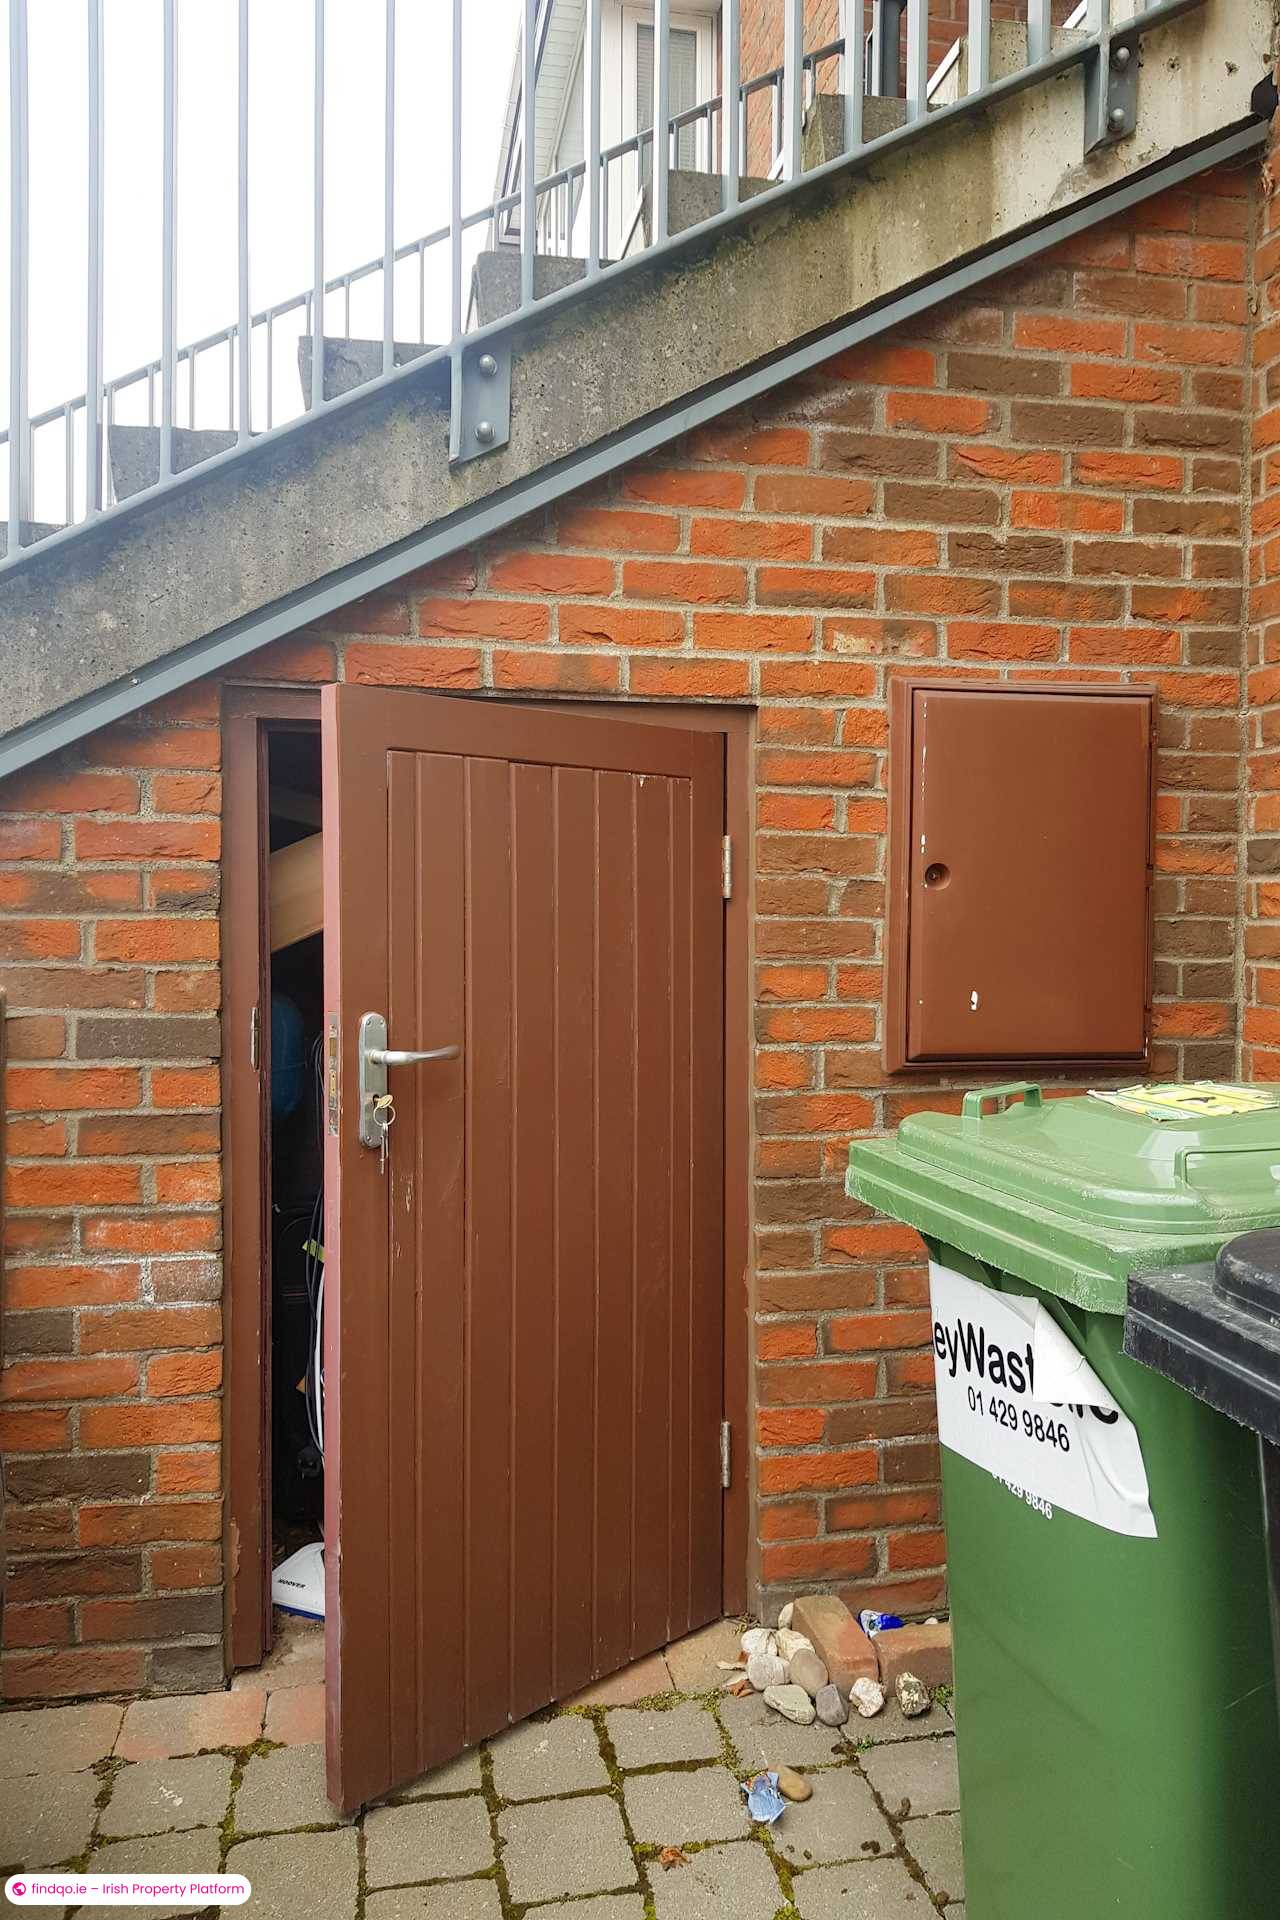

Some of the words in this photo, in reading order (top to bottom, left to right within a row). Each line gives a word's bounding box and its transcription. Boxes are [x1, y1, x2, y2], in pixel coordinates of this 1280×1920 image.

[967, 1385, 984, 1417] 01
[989, 1396, 1018, 1431] 429
[1023, 1410, 1070, 1452] 9846
[1025, 1488, 1053, 1520] 9846
